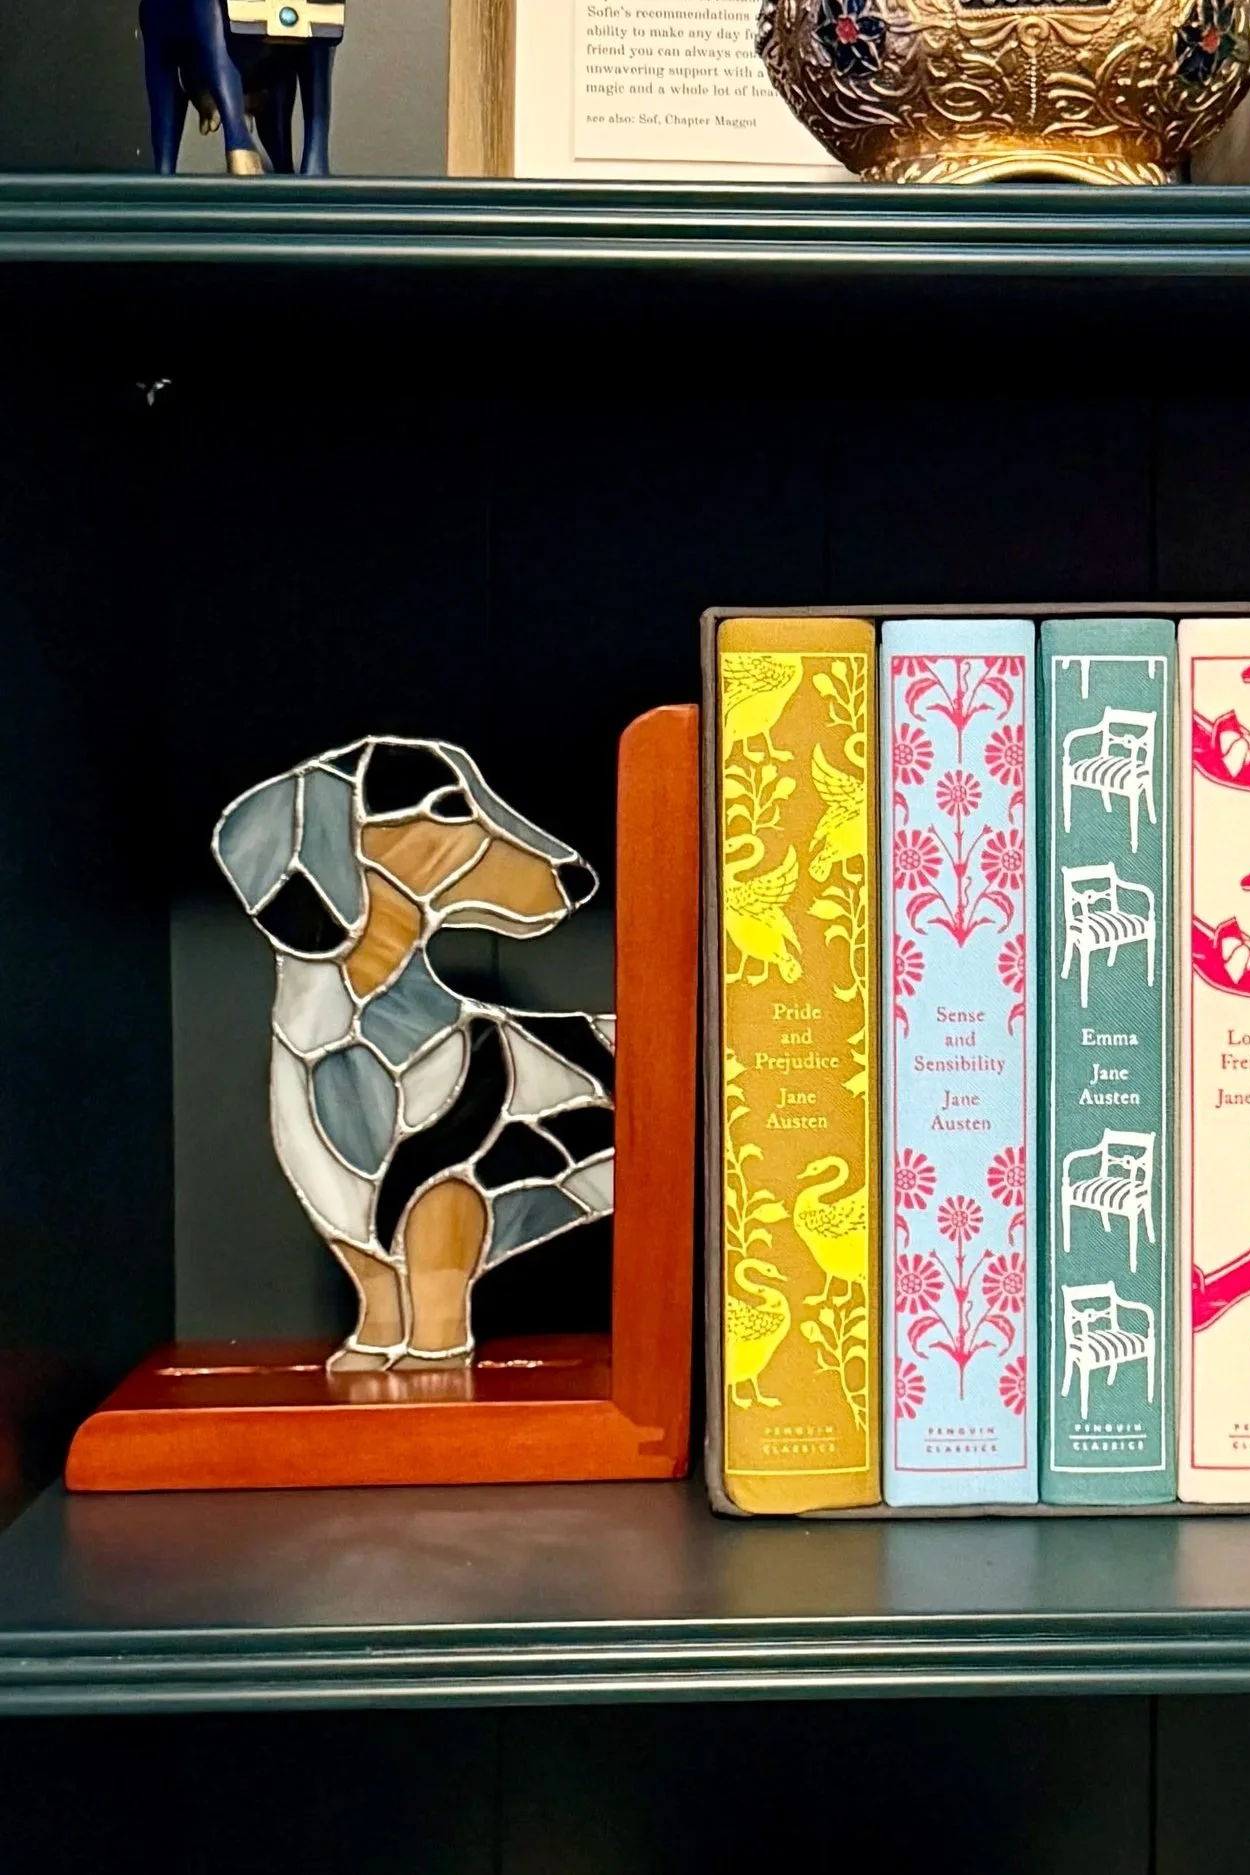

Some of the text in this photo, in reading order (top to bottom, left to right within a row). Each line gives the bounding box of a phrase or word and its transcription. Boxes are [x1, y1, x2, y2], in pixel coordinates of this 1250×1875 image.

[587, 6, 750, 21] Sofie's recommendations
[586, 25, 627, 39] ability
[632, 27, 645, 37] to
[649, 26, 684, 38] make
[688, 30, 712, 42] any
[716, 28, 740, 42] day
[586, 43, 625, 56] friend
[629, 47, 652, 59] you
[657, 47, 680, 57] can
[684, 46, 731, 60] always
[586, 65, 765, 79] unwavering support with a
[586, 82, 625, 96] magic
[629, 82, 653, 94] and
[658, 86, 665, 94] a
[670, 84, 709, 95] whole
[713, 85, 729, 96] lot
[734, 85, 748, 96] of
[608, 112, 635, 124] also:
[665, 114, 710, 127] Chapter
[715, 115, 757, 128] Maggot
[772, 1003, 821, 1021] Pride
[936, 1006, 985, 1023] Sense
[780, 1028, 813, 1045] and
[945, 1031, 976, 1048] and
[1081, 1028, 1139, 1046] Emma
[754, 1052, 840, 1071] Prejudice
[914, 1055, 1005, 1075] Sensibility
[1089, 1064, 1129, 1082] Jane
[777, 1087, 817, 1108] Jane
[942, 1089, 980, 1108] Jane
[1079, 1089, 1140, 1106] Austen
[1215, 1088, 1250, 1108] Jane
[765, 1111, 828, 1130] Austen
[931, 1114, 991, 1131] Austen
[1074, 1423, 1142, 1433] PENGUIN
[1072, 1440, 1144, 1451] CLASSICS
